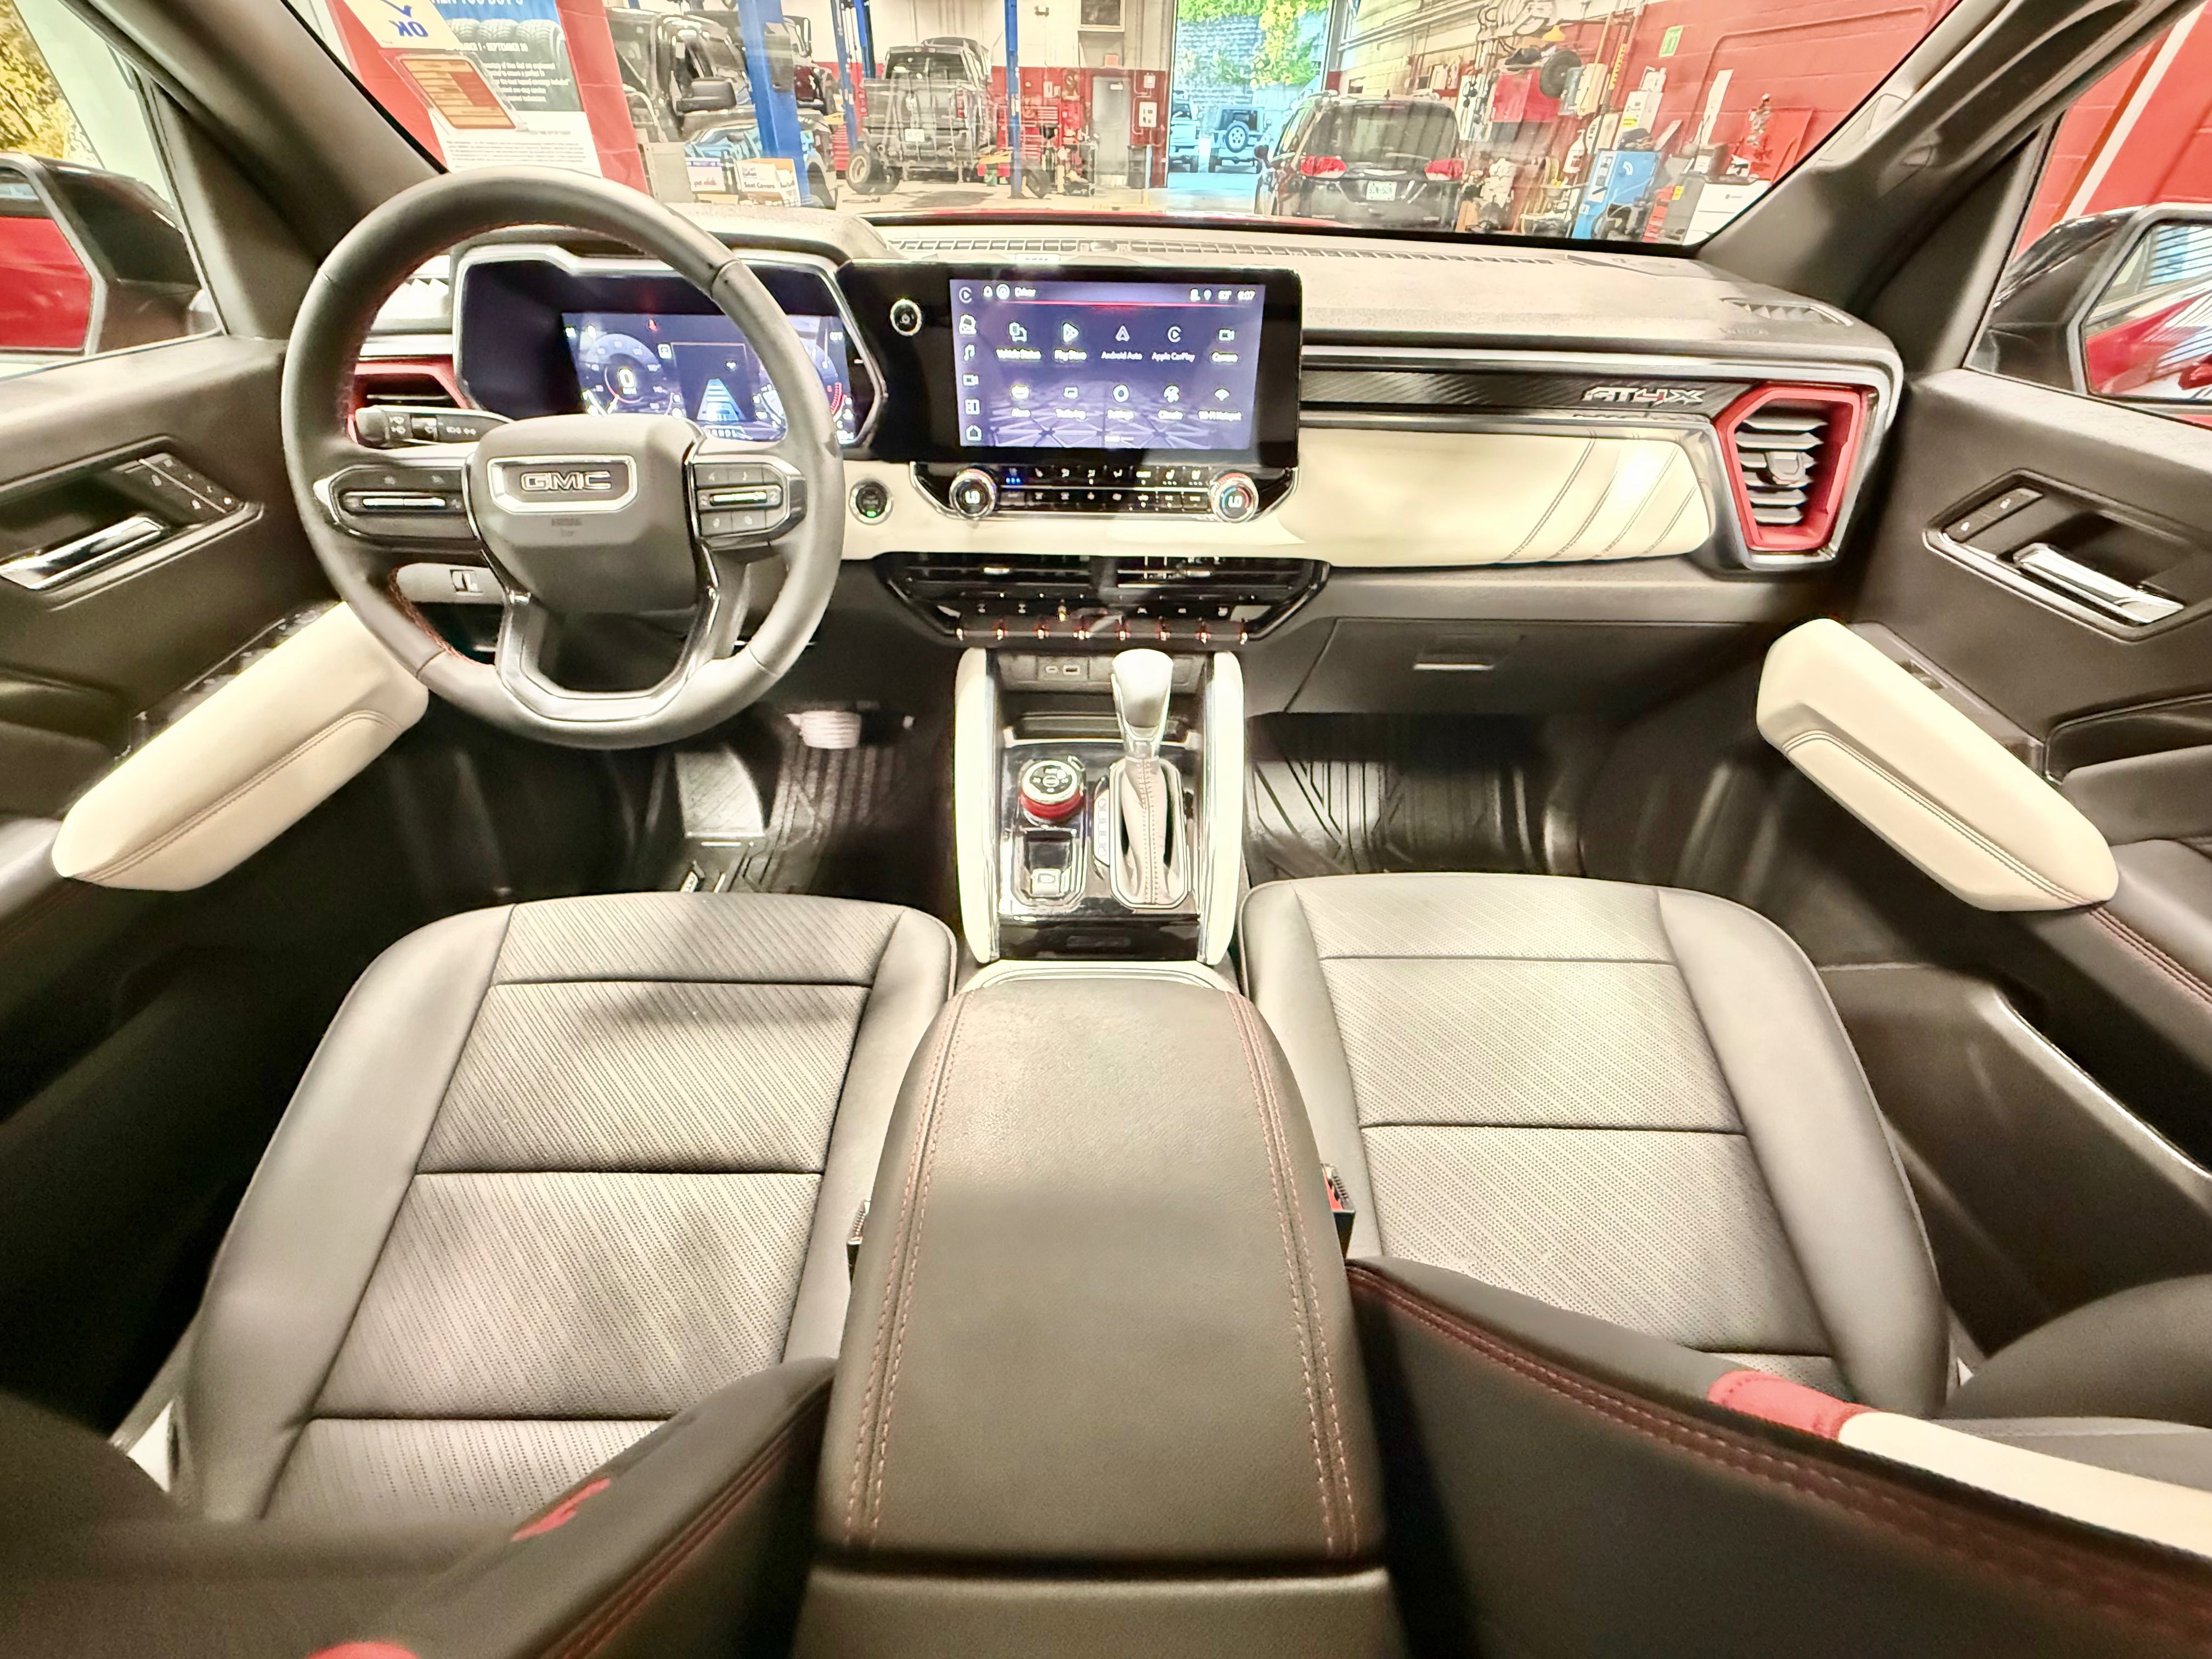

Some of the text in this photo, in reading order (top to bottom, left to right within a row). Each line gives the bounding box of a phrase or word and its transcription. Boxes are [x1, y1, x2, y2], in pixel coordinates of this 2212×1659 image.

[1101, 351, 1127, 360] Android
[1152, 351, 1171, 362] Apple
[618, 368, 634, 388] 0
[1581, 386, 1706, 407] AT4X
[521, 471, 612, 491] GMC
